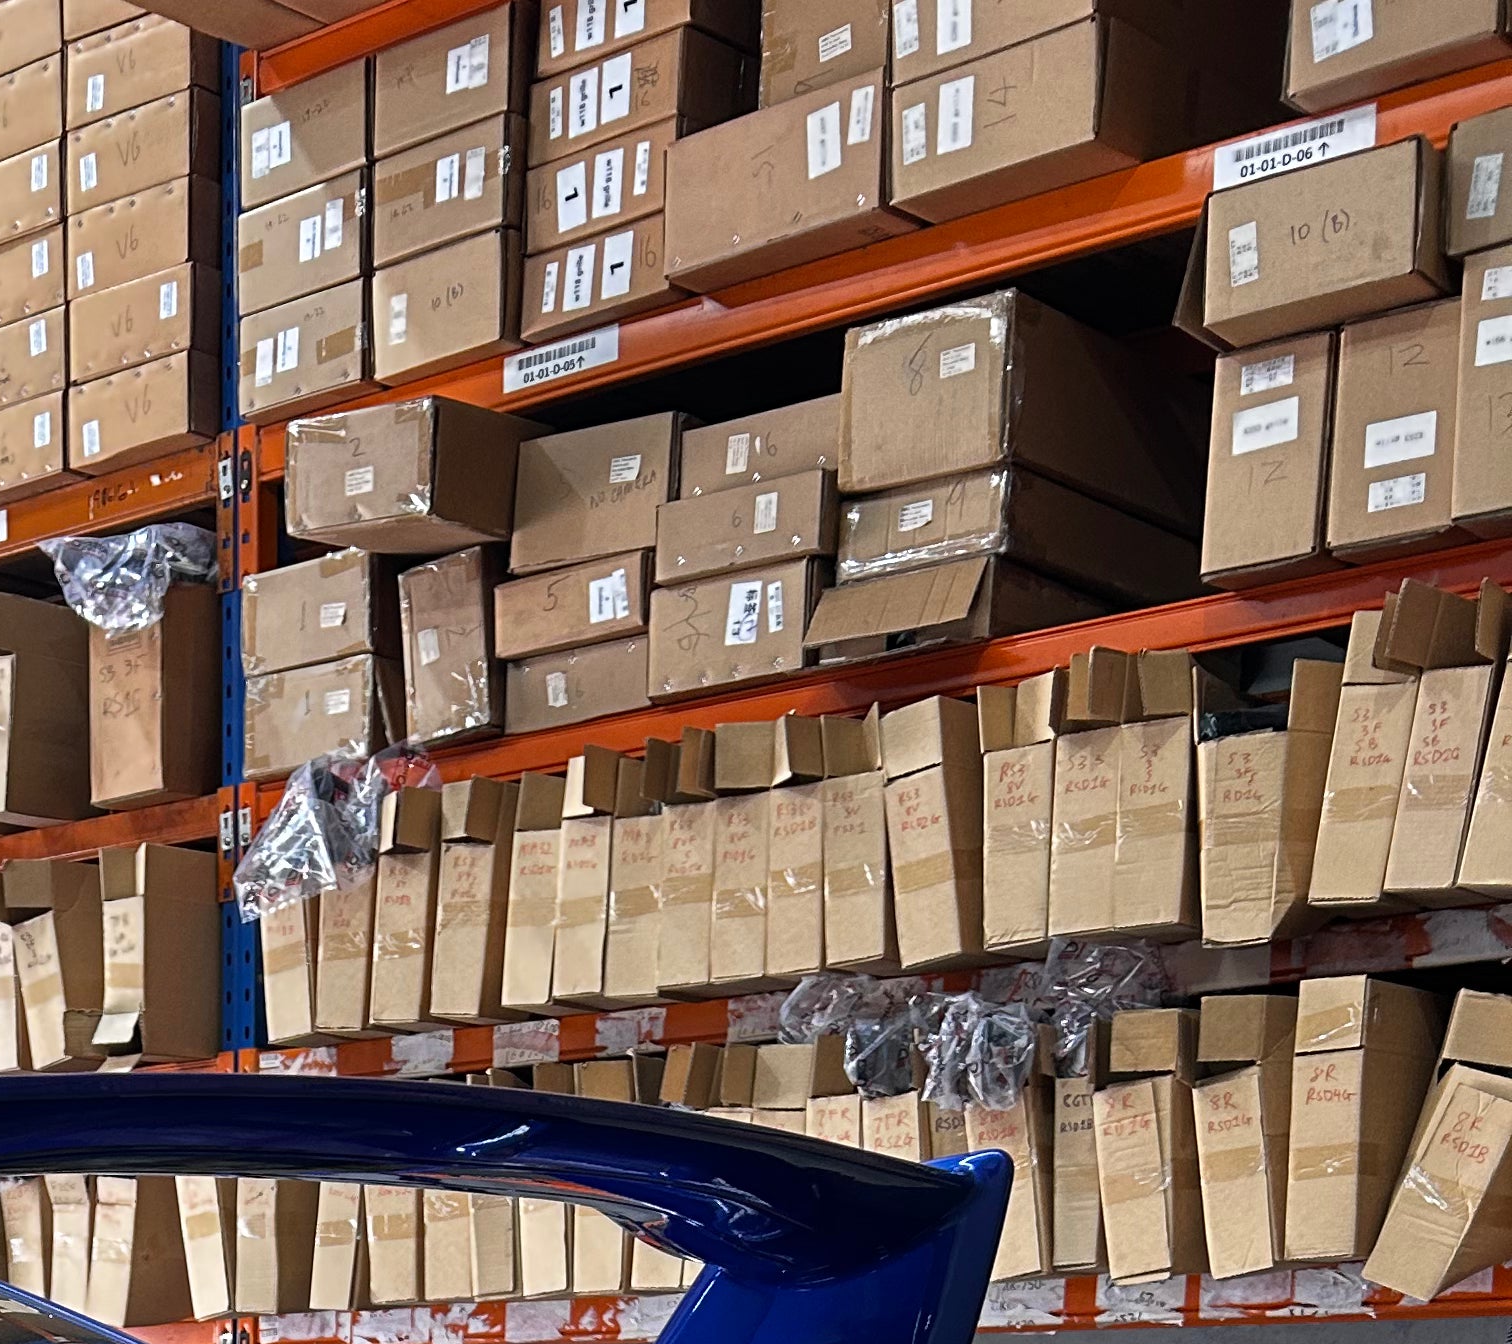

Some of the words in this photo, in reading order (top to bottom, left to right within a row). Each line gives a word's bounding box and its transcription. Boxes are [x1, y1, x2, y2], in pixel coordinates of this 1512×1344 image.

[116, 49, 136, 73] V6
[117, 131, 141, 167] V6
[1240, 147, 1313, 178] 01-01-D-06
[1290, 222, 1310, 245] 10
[1321, 209, 1350, 243] (B)
[117, 226, 140, 261] V6
[639, 234, 657, 268] 16
[111, 310, 134, 338] V6
[523, 358, 576, 384] 01-01-D-05
[1389, 344, 1430, 377] 12
[125, 384, 152, 424] V6
[349, 437, 366, 457] 2
[765, 432, 777, 457] 6
[1248, 459, 1288, 494] 12
[731, 508, 742, 528] 6
[999, 761, 1026, 783] RS3
[1309, 1063, 1338, 1083] 8R
[1209, 1092, 1238, 1110] 8R
[1306, 1086, 1357, 1105] RSD4G
[873, 1110, 910, 1134] 7FR
[1453, 1111, 1484, 1132] 8R
